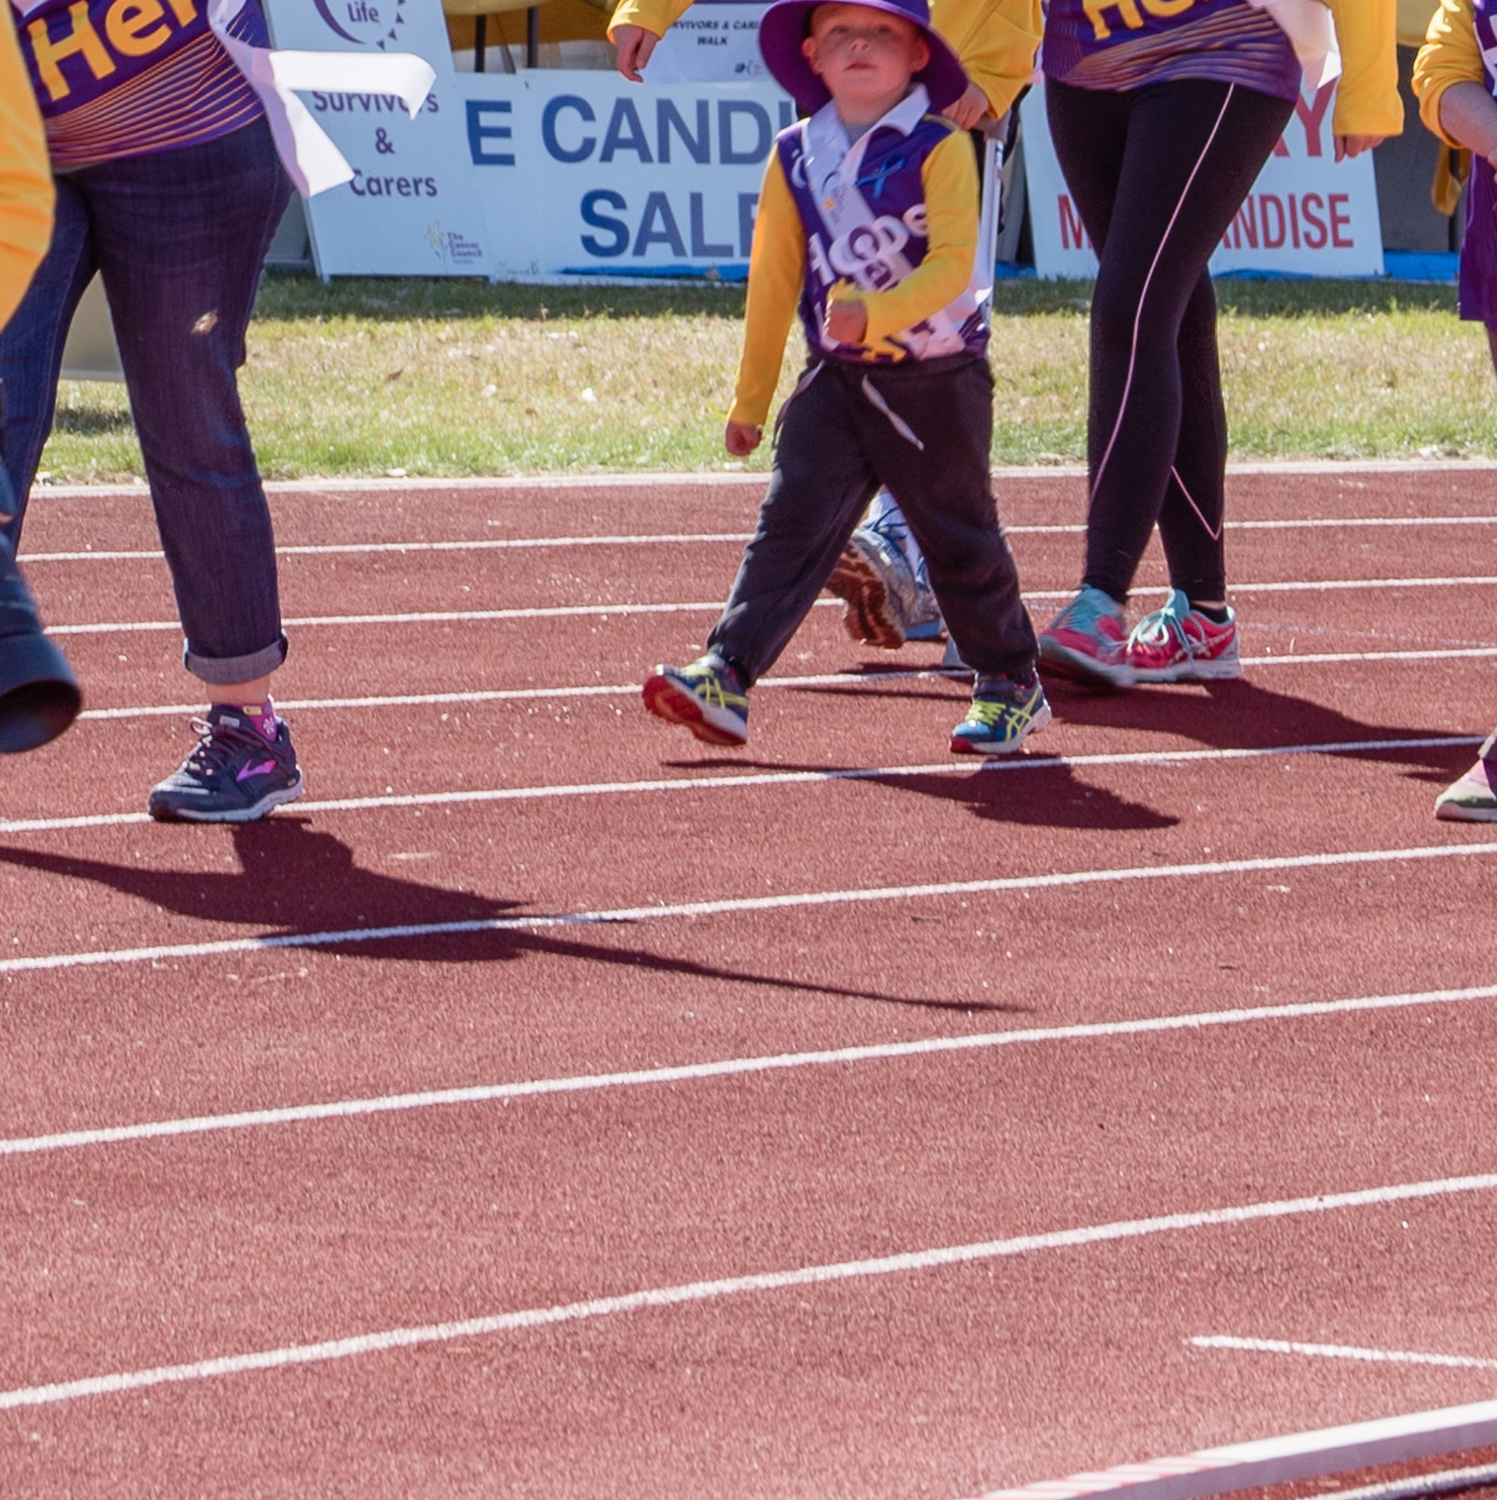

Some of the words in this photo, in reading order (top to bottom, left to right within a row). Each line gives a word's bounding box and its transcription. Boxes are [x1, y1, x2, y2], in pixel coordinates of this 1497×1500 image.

[347, 2, 379, 24] Life
[671, 20, 719, 31] RVIVORS
[733, 21, 759, 31] CAR
[697, 36, 728, 46] WALK
[313, 89, 439, 115] Survivs
[375, 127, 396, 154] &
[349, 172, 438, 197] Carers
